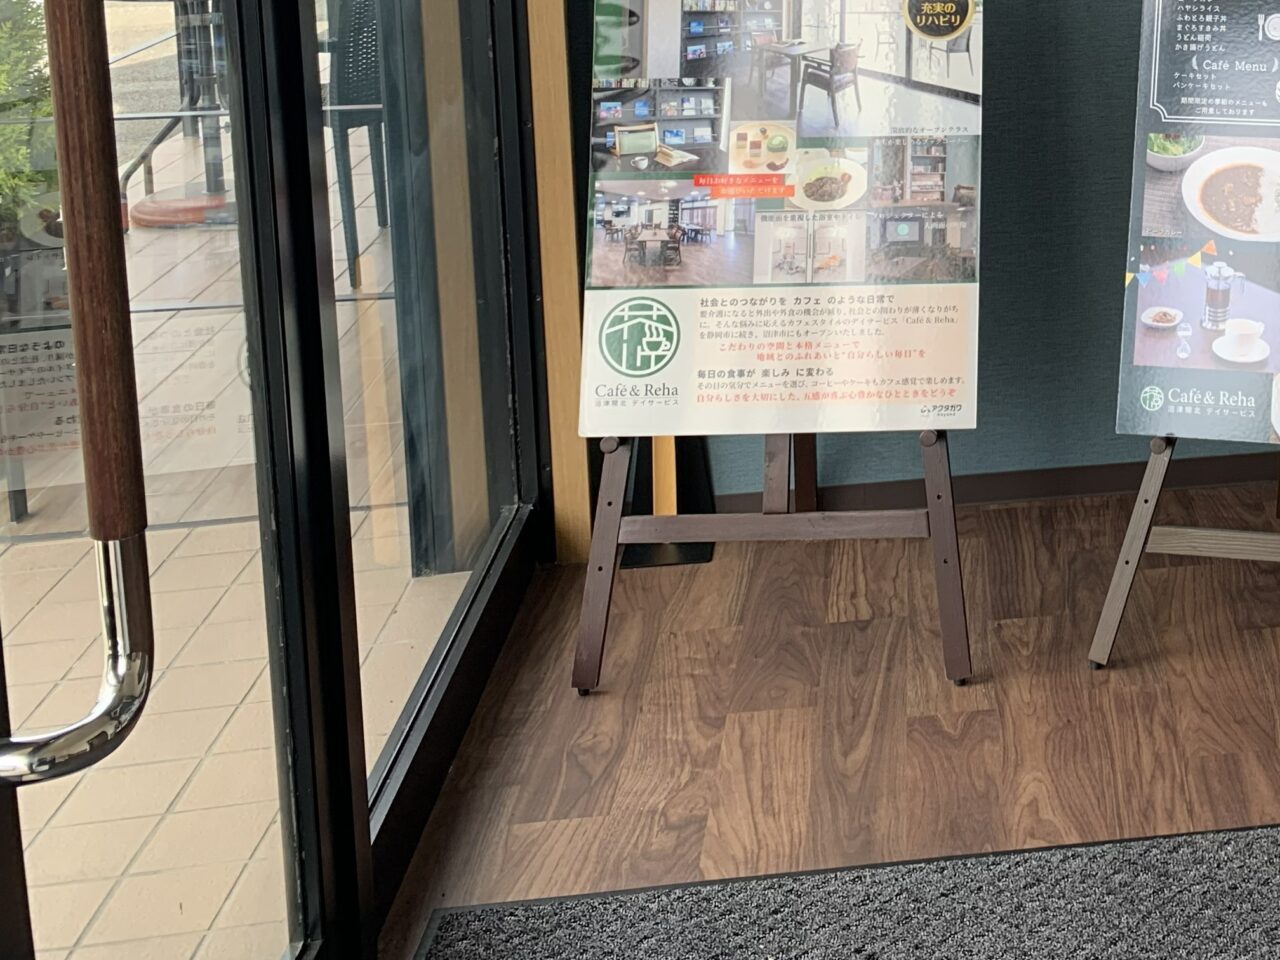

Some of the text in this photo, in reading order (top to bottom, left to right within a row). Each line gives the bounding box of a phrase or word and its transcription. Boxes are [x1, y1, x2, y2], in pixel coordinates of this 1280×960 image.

[921, 2, 956, 14] 充実の
[916, 15, 960, 26] リハビリ
[1202, 59, 1267, 71] Café Menu
[1173, 72, 1216, 80] ケーキセット
[793, 296, 821, 304] カフェ
[697, 367, 834, 379] 毎日の食事が 楽しみ に変わる
[595, 382, 679, 397] Café & Reha
[1168, 387, 1256, 407] Café & Reha
